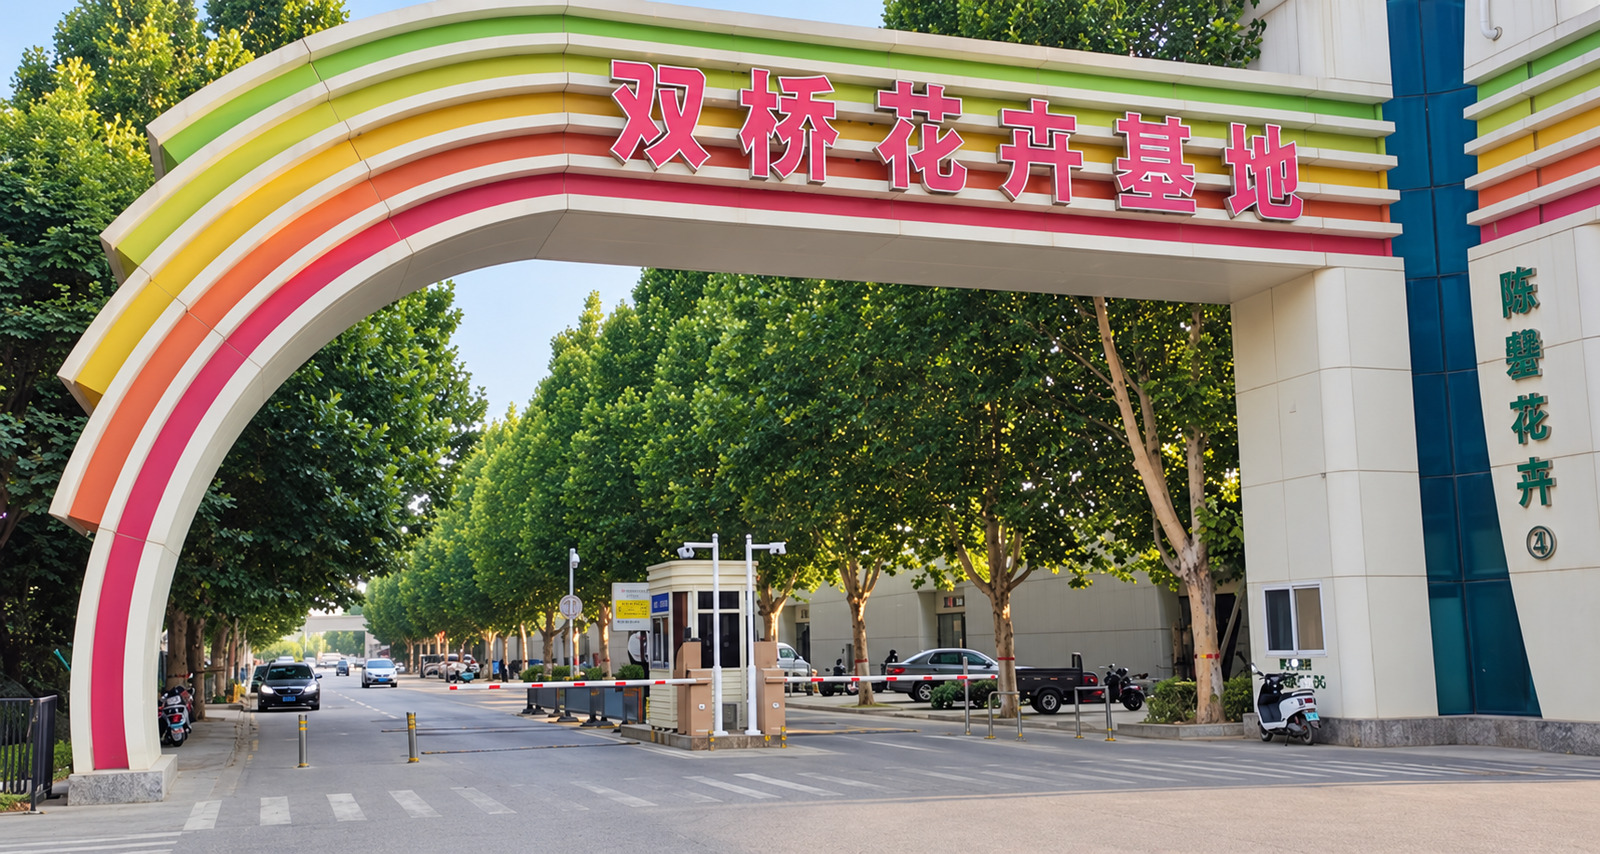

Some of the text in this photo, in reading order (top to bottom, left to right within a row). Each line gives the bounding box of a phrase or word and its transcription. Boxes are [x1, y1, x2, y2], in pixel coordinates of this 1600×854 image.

[608, 59, 1303, 222] 双桥花卉基地
